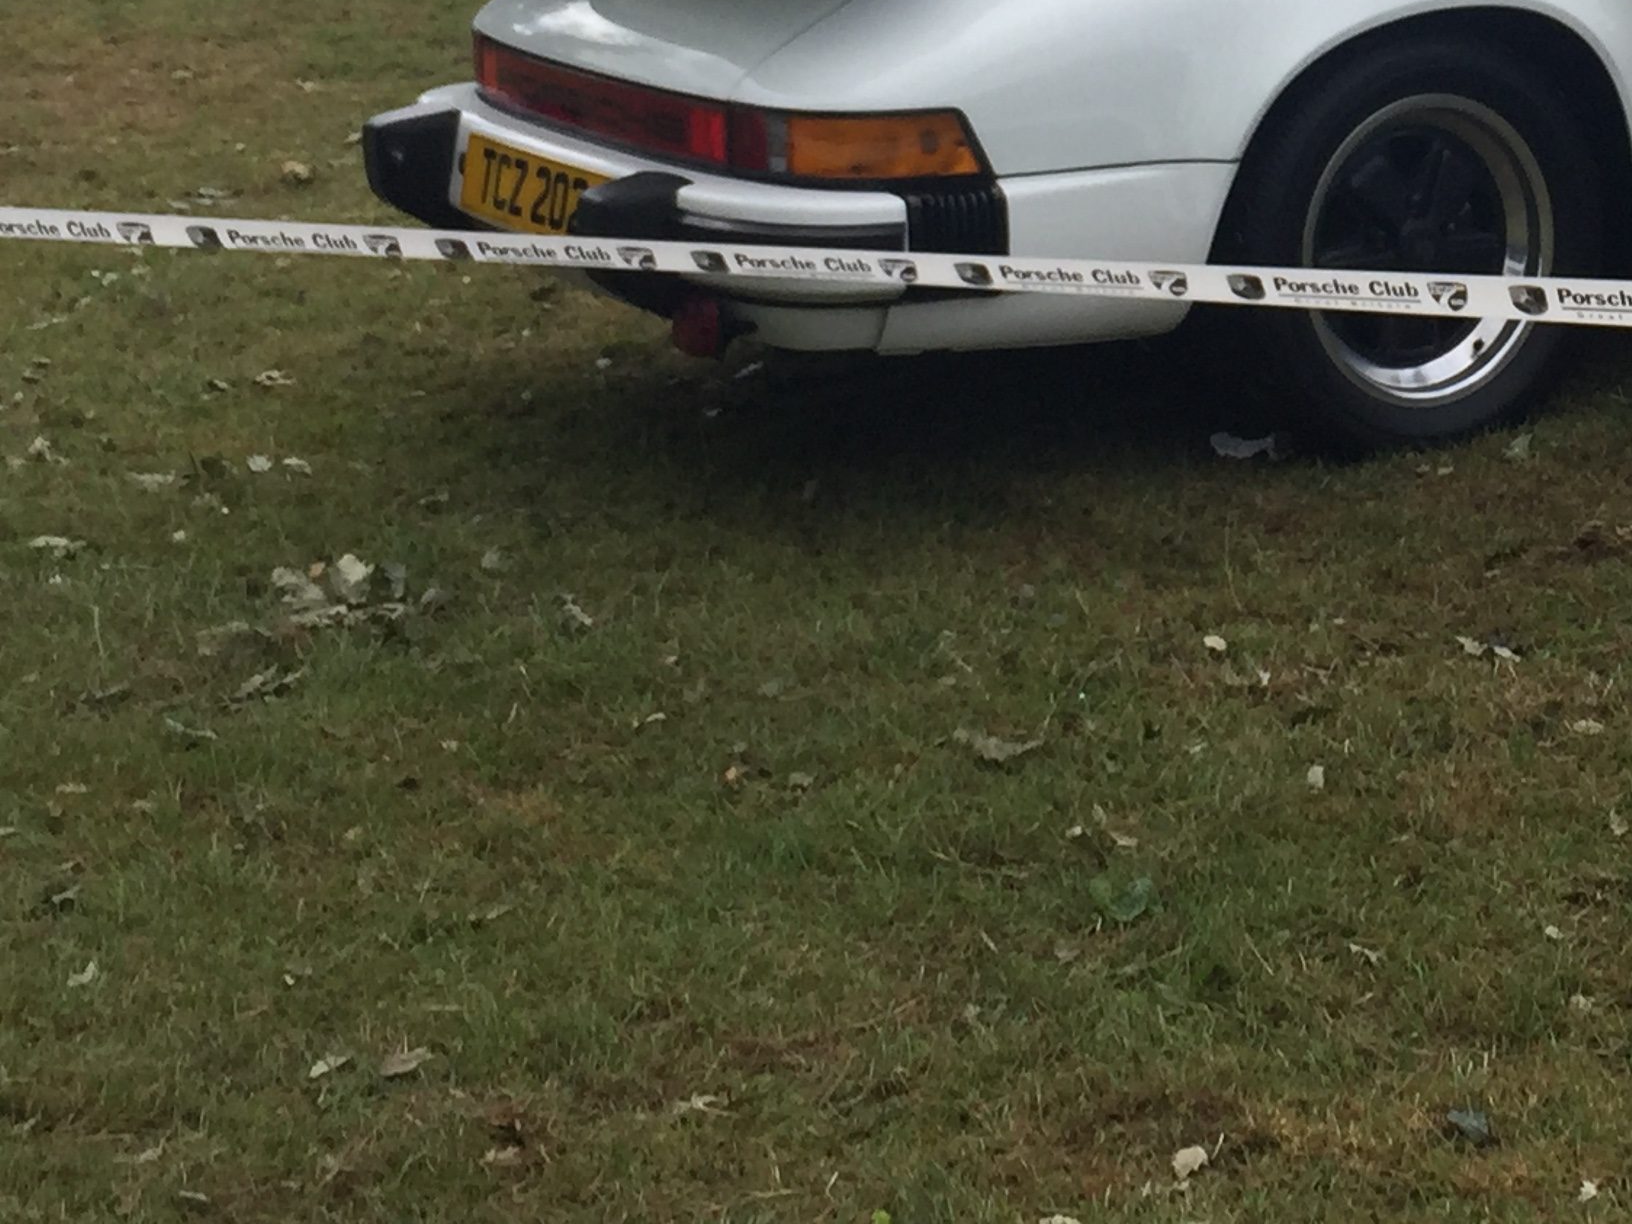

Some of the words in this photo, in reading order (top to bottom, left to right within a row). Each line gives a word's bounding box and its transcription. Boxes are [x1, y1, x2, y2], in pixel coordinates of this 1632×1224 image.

[481, 147, 529, 217] TCZ
[66, 220, 112, 237] Club
[226, 228, 305, 248] Porsche
[312, 233, 357, 250] Club
[476, 241, 556, 259] Porsche
[565, 244, 611, 262] Club
[734, 253, 816, 271] Porsche
[824, 256, 871, 273] Club
[999, 264, 1084, 283] Porsche
[1091, 268, 1141, 285] Club
[1273, 277, 1360, 296] Porsche
[1368, 280, 1419, 298] Club
